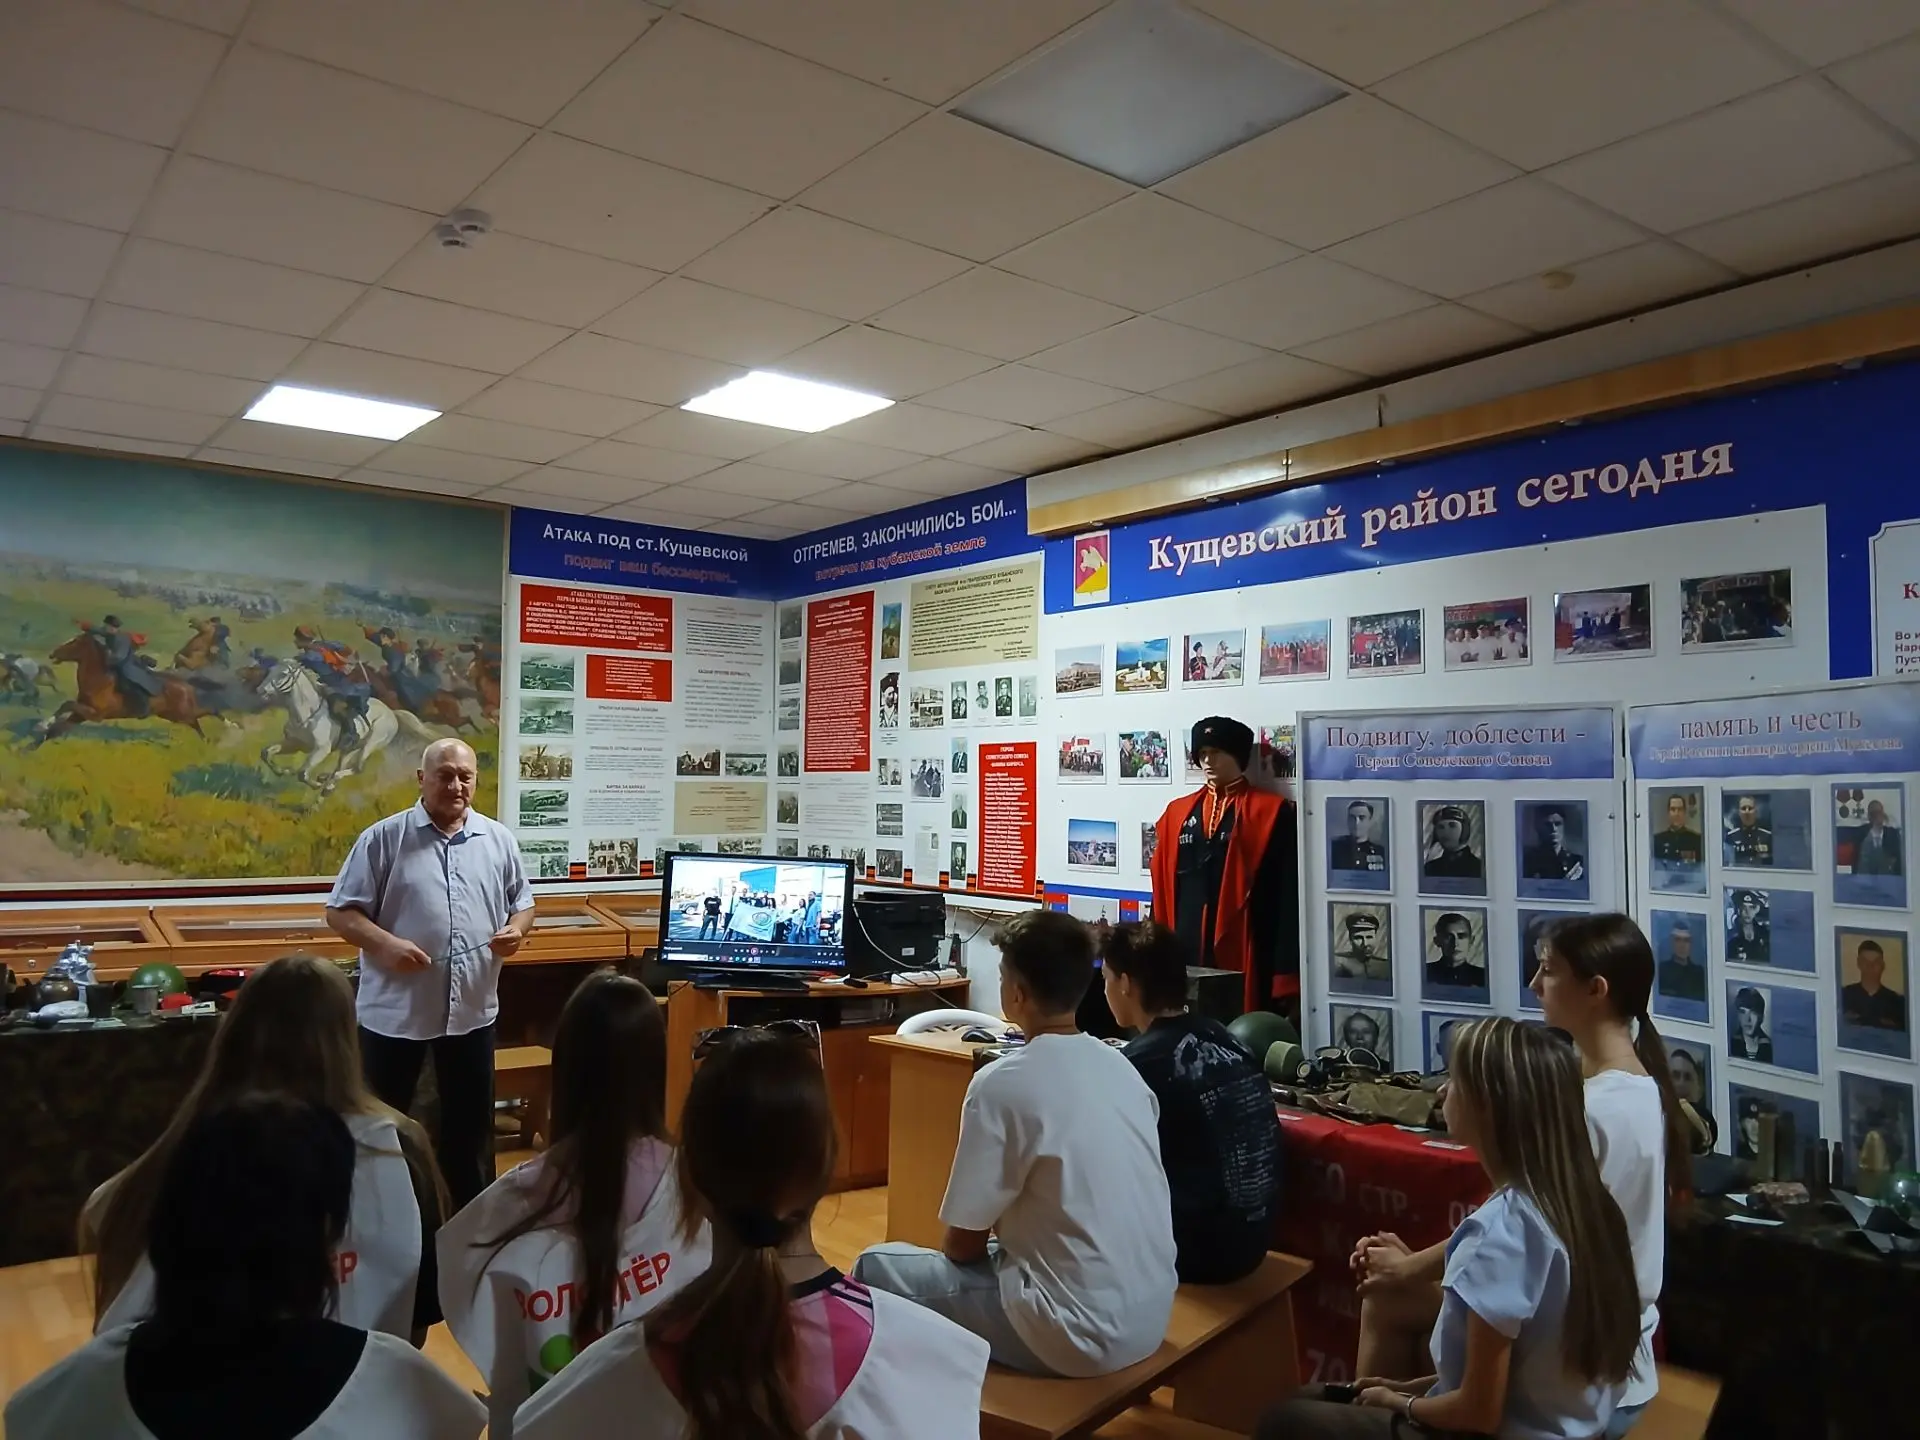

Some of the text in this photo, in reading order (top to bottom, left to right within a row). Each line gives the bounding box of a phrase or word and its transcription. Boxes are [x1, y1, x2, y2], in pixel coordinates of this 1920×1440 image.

[1148, 442, 1734, 576] Кущевский район сегодня
[793, 499, 1017, 564] ОТГРЕМЕВ, ЗАКОНЧИЛИСЬ БОИ...
[564, 553, 614, 571] подвиг
[636, 537, 748, 562] ст.Кущевской
[861, 559, 875, 572] на
[876, 543, 943, 570] кубанской
[945, 536, 986, 554] земле
[1895, 631, 1910, 640] Во
[1895, 643, 1920, 654] Нар
[1325, 726, 1434, 751] Подвигу,
[1443, 722, 1566, 748] доблести
[1680, 710, 1862, 740] память и честь
[1355, 752, 1552, 771] Герои Советского Союза
